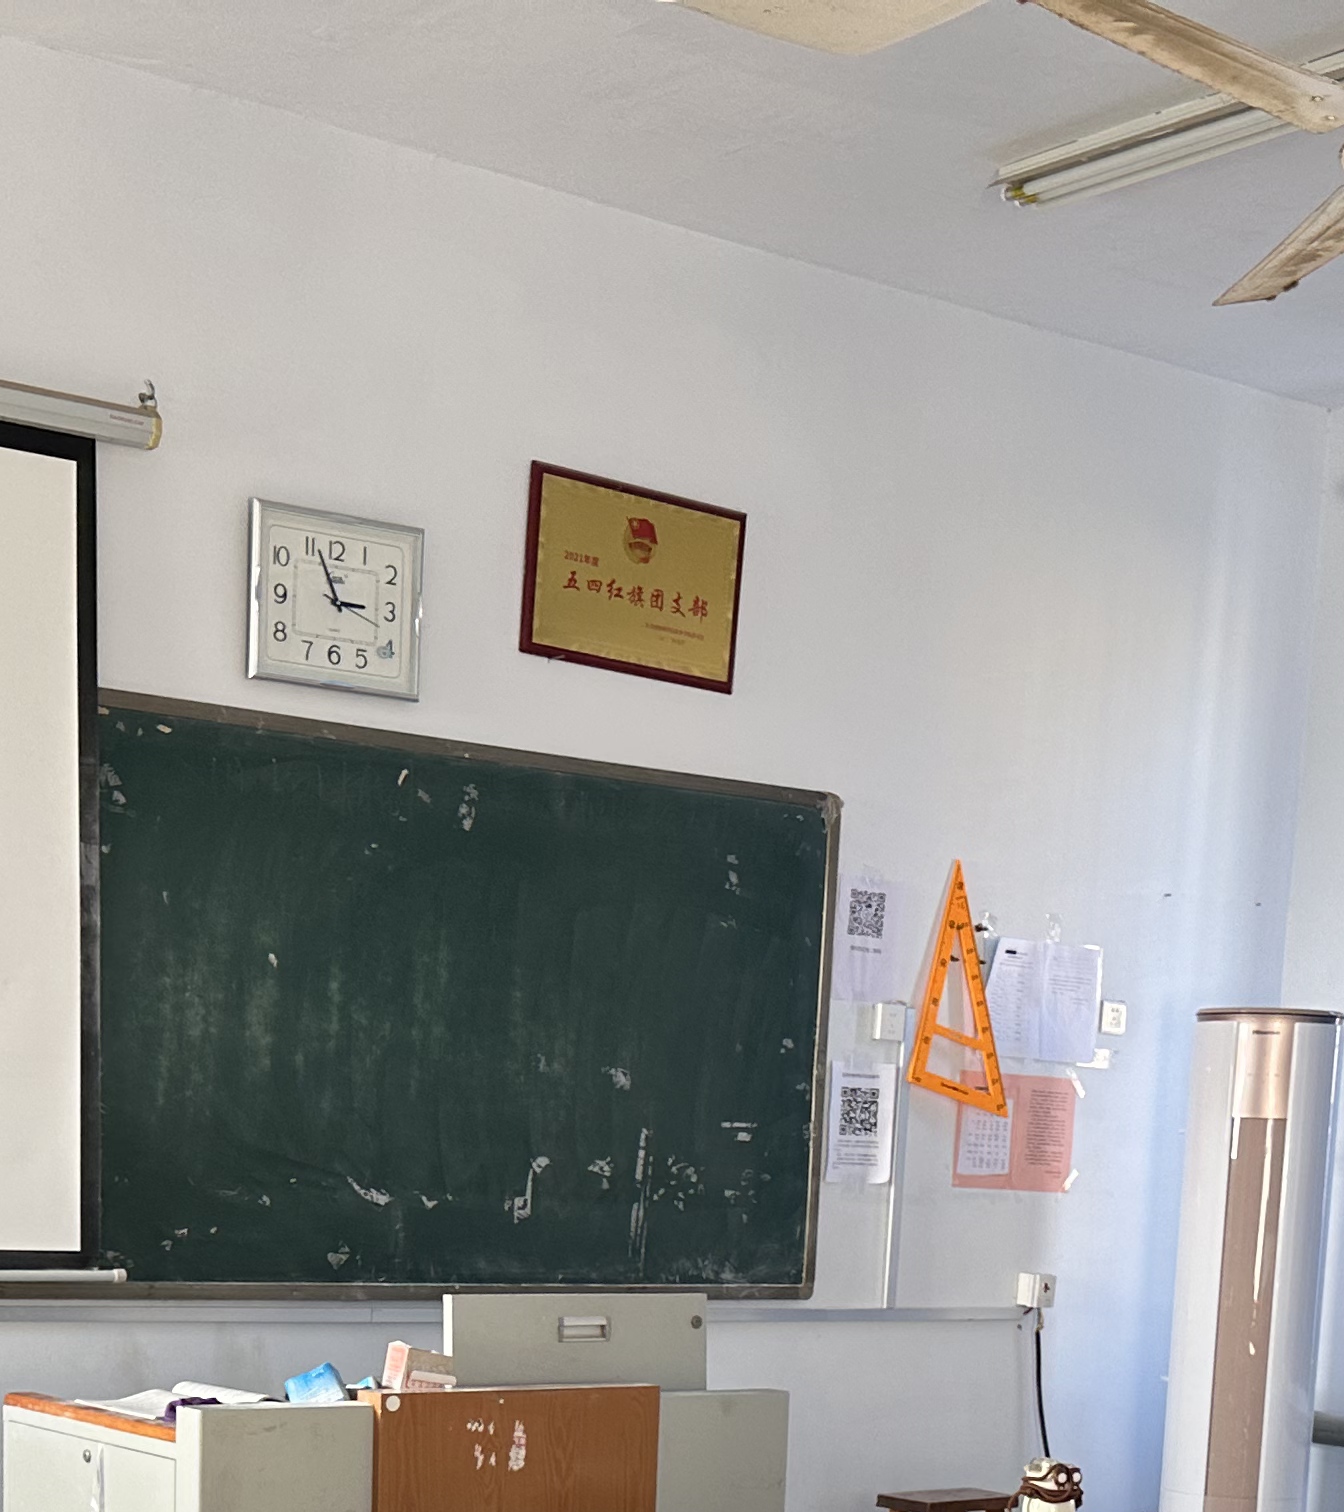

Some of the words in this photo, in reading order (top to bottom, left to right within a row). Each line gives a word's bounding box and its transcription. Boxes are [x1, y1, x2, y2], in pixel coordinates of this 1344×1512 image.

[273, 545, 290, 567] 10
[305, 535, 316, 557] 11
[328, 540, 346, 562] 12
[362, 545, 368, 566] 1
[563, 549, 600, 568] 2021年度
[384, 564, 398, 586] 2
[273, 583, 288, 604] 9
[562, 570, 709, 623] 五四红旗团支部
[383, 601, 397, 623] 3
[273, 620, 288, 642] 8
[301, 639, 314, 661] 7
[327, 644, 342, 666] 6
[355, 648, 368, 669] 5
